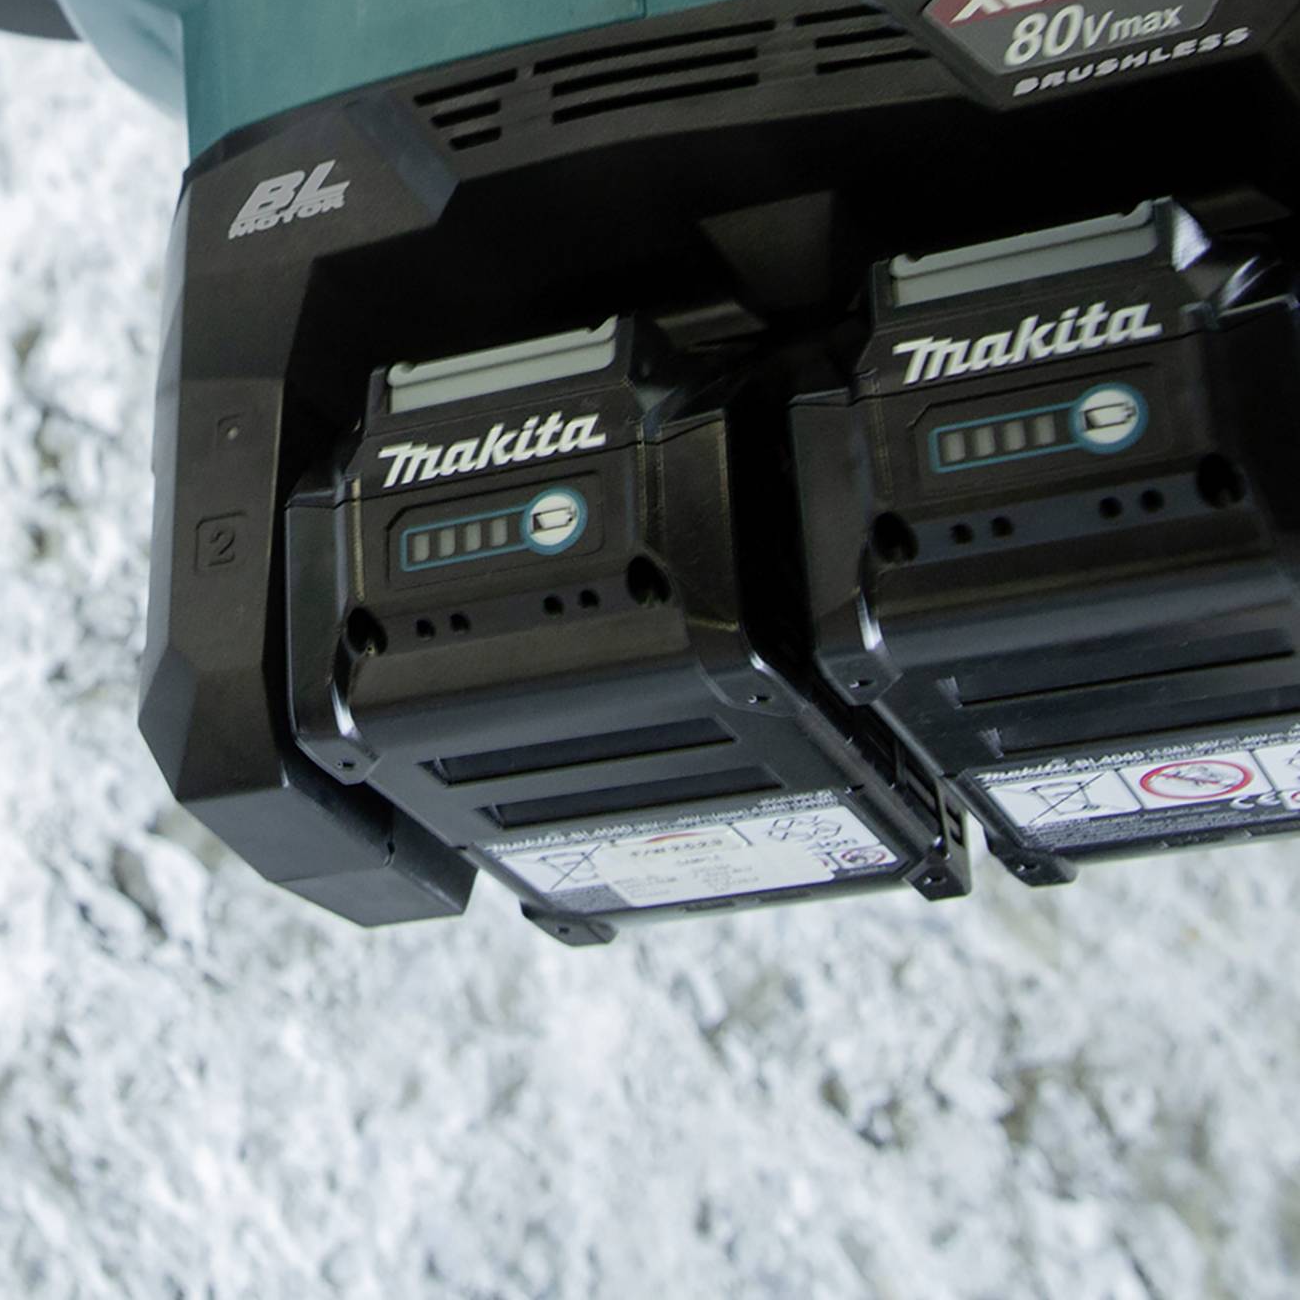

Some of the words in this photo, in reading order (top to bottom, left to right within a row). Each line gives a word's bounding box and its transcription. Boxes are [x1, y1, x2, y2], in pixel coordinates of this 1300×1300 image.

[1012, 26, 1250, 97] BRUSHLESS
[228, 192, 346, 240] MOTOR
[237, 159, 350, 221] BL
[207, 530, 237, 568] 2
